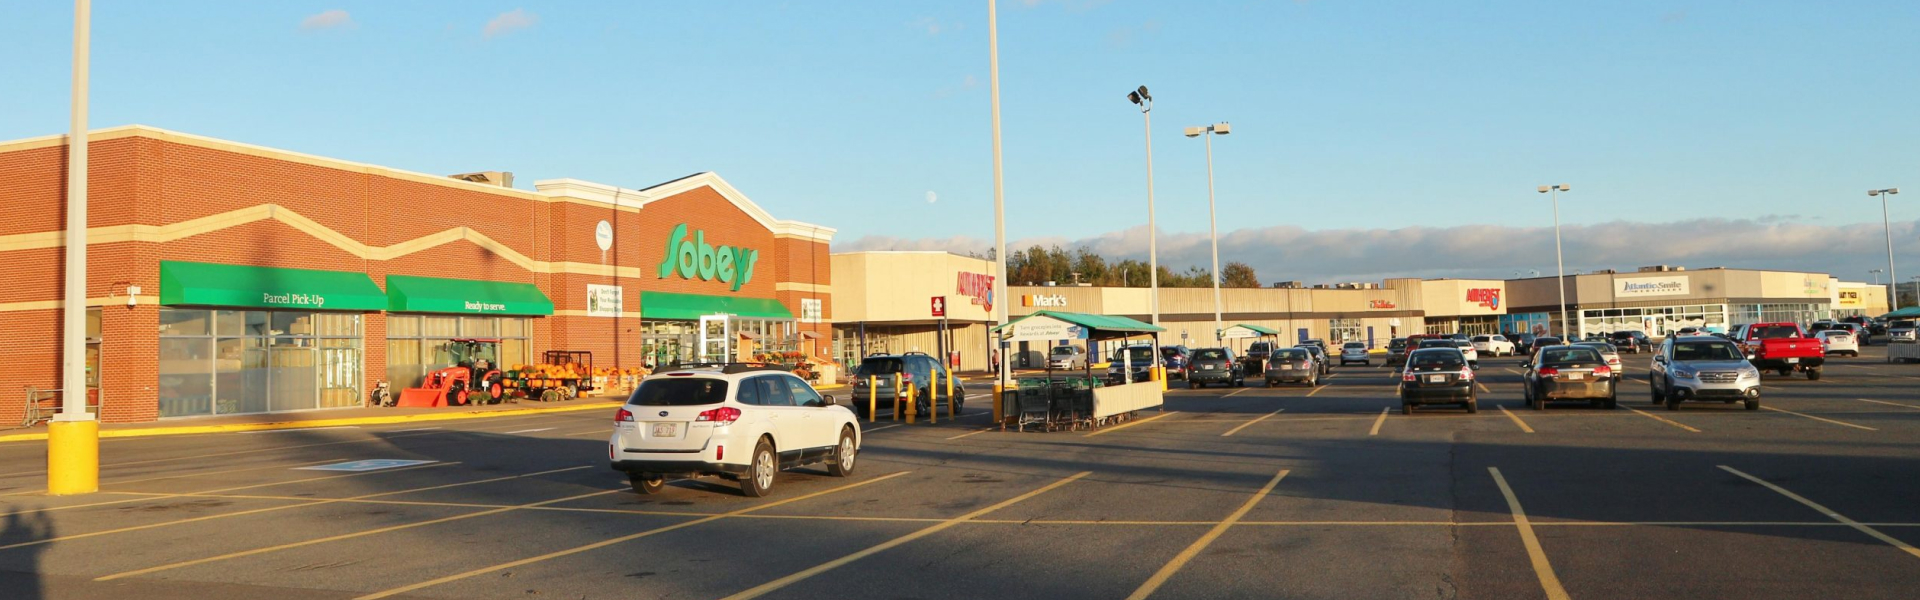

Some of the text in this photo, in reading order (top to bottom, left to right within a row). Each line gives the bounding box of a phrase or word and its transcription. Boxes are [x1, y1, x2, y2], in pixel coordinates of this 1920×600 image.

[657, 223, 758, 291] Sobeys
[1624, 281, 1681, 291] Atlantic Smile
[263, 293, 325, 308] Parcel Pick-Up
[465, 301, 482, 312] Ready
[1033, 294, 1067, 307] Mark's
